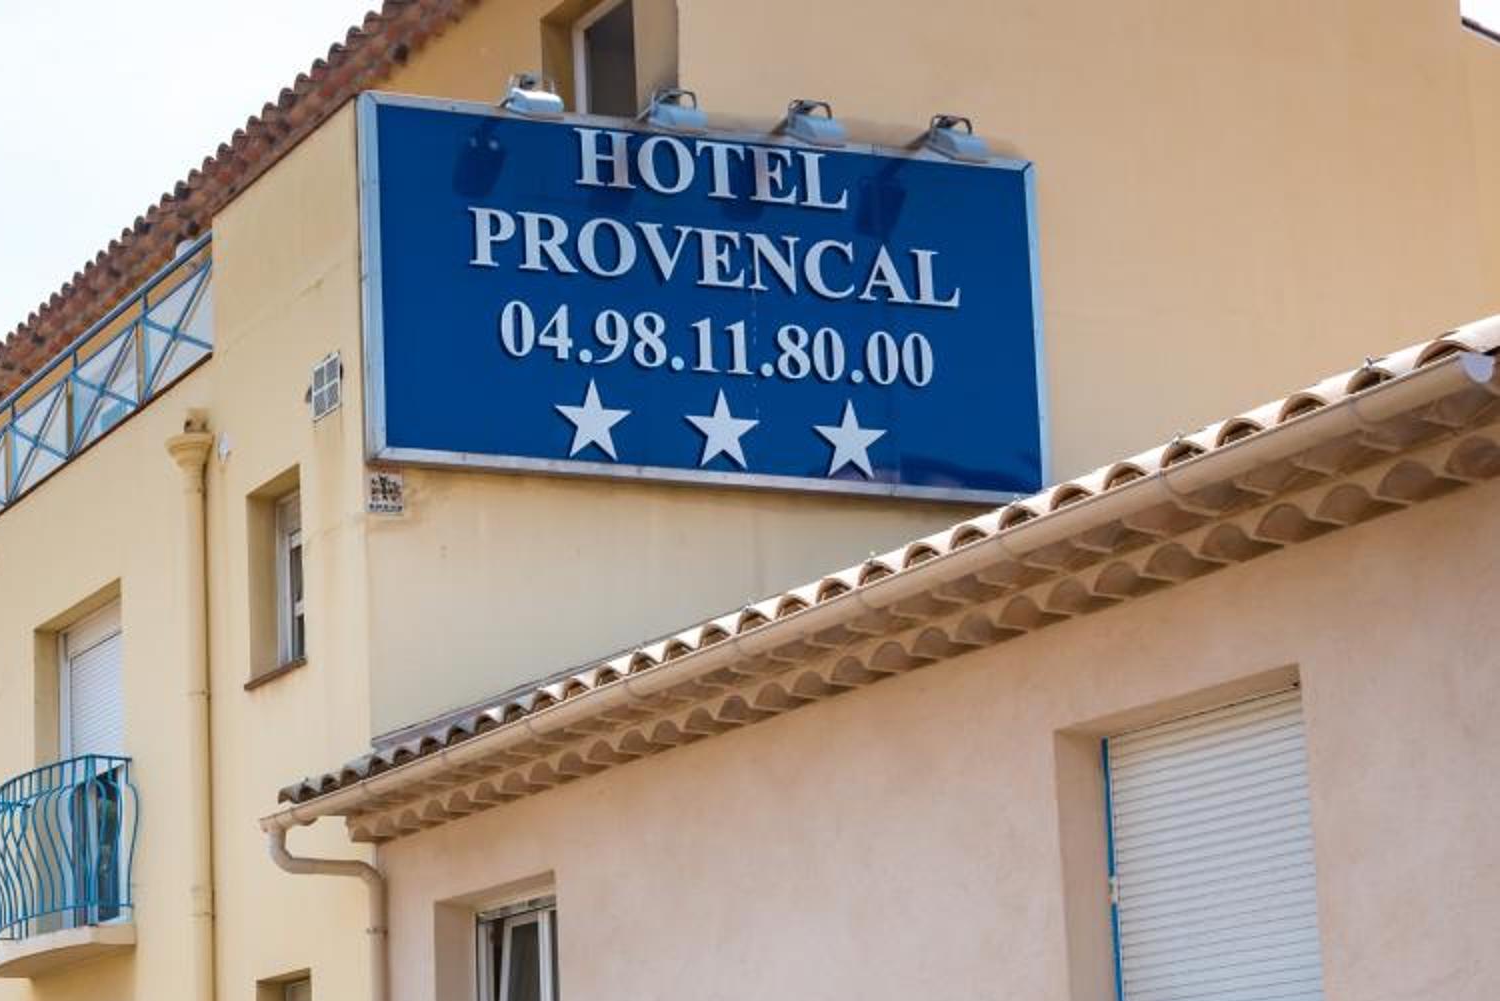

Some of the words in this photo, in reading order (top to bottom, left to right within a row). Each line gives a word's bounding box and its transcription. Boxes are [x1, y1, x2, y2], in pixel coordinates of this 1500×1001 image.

[574, 128, 848, 210] HOTEL
[468, 206, 961, 308] PROVENCAL
[501, 300, 934, 387] 04.98.11.80.00
